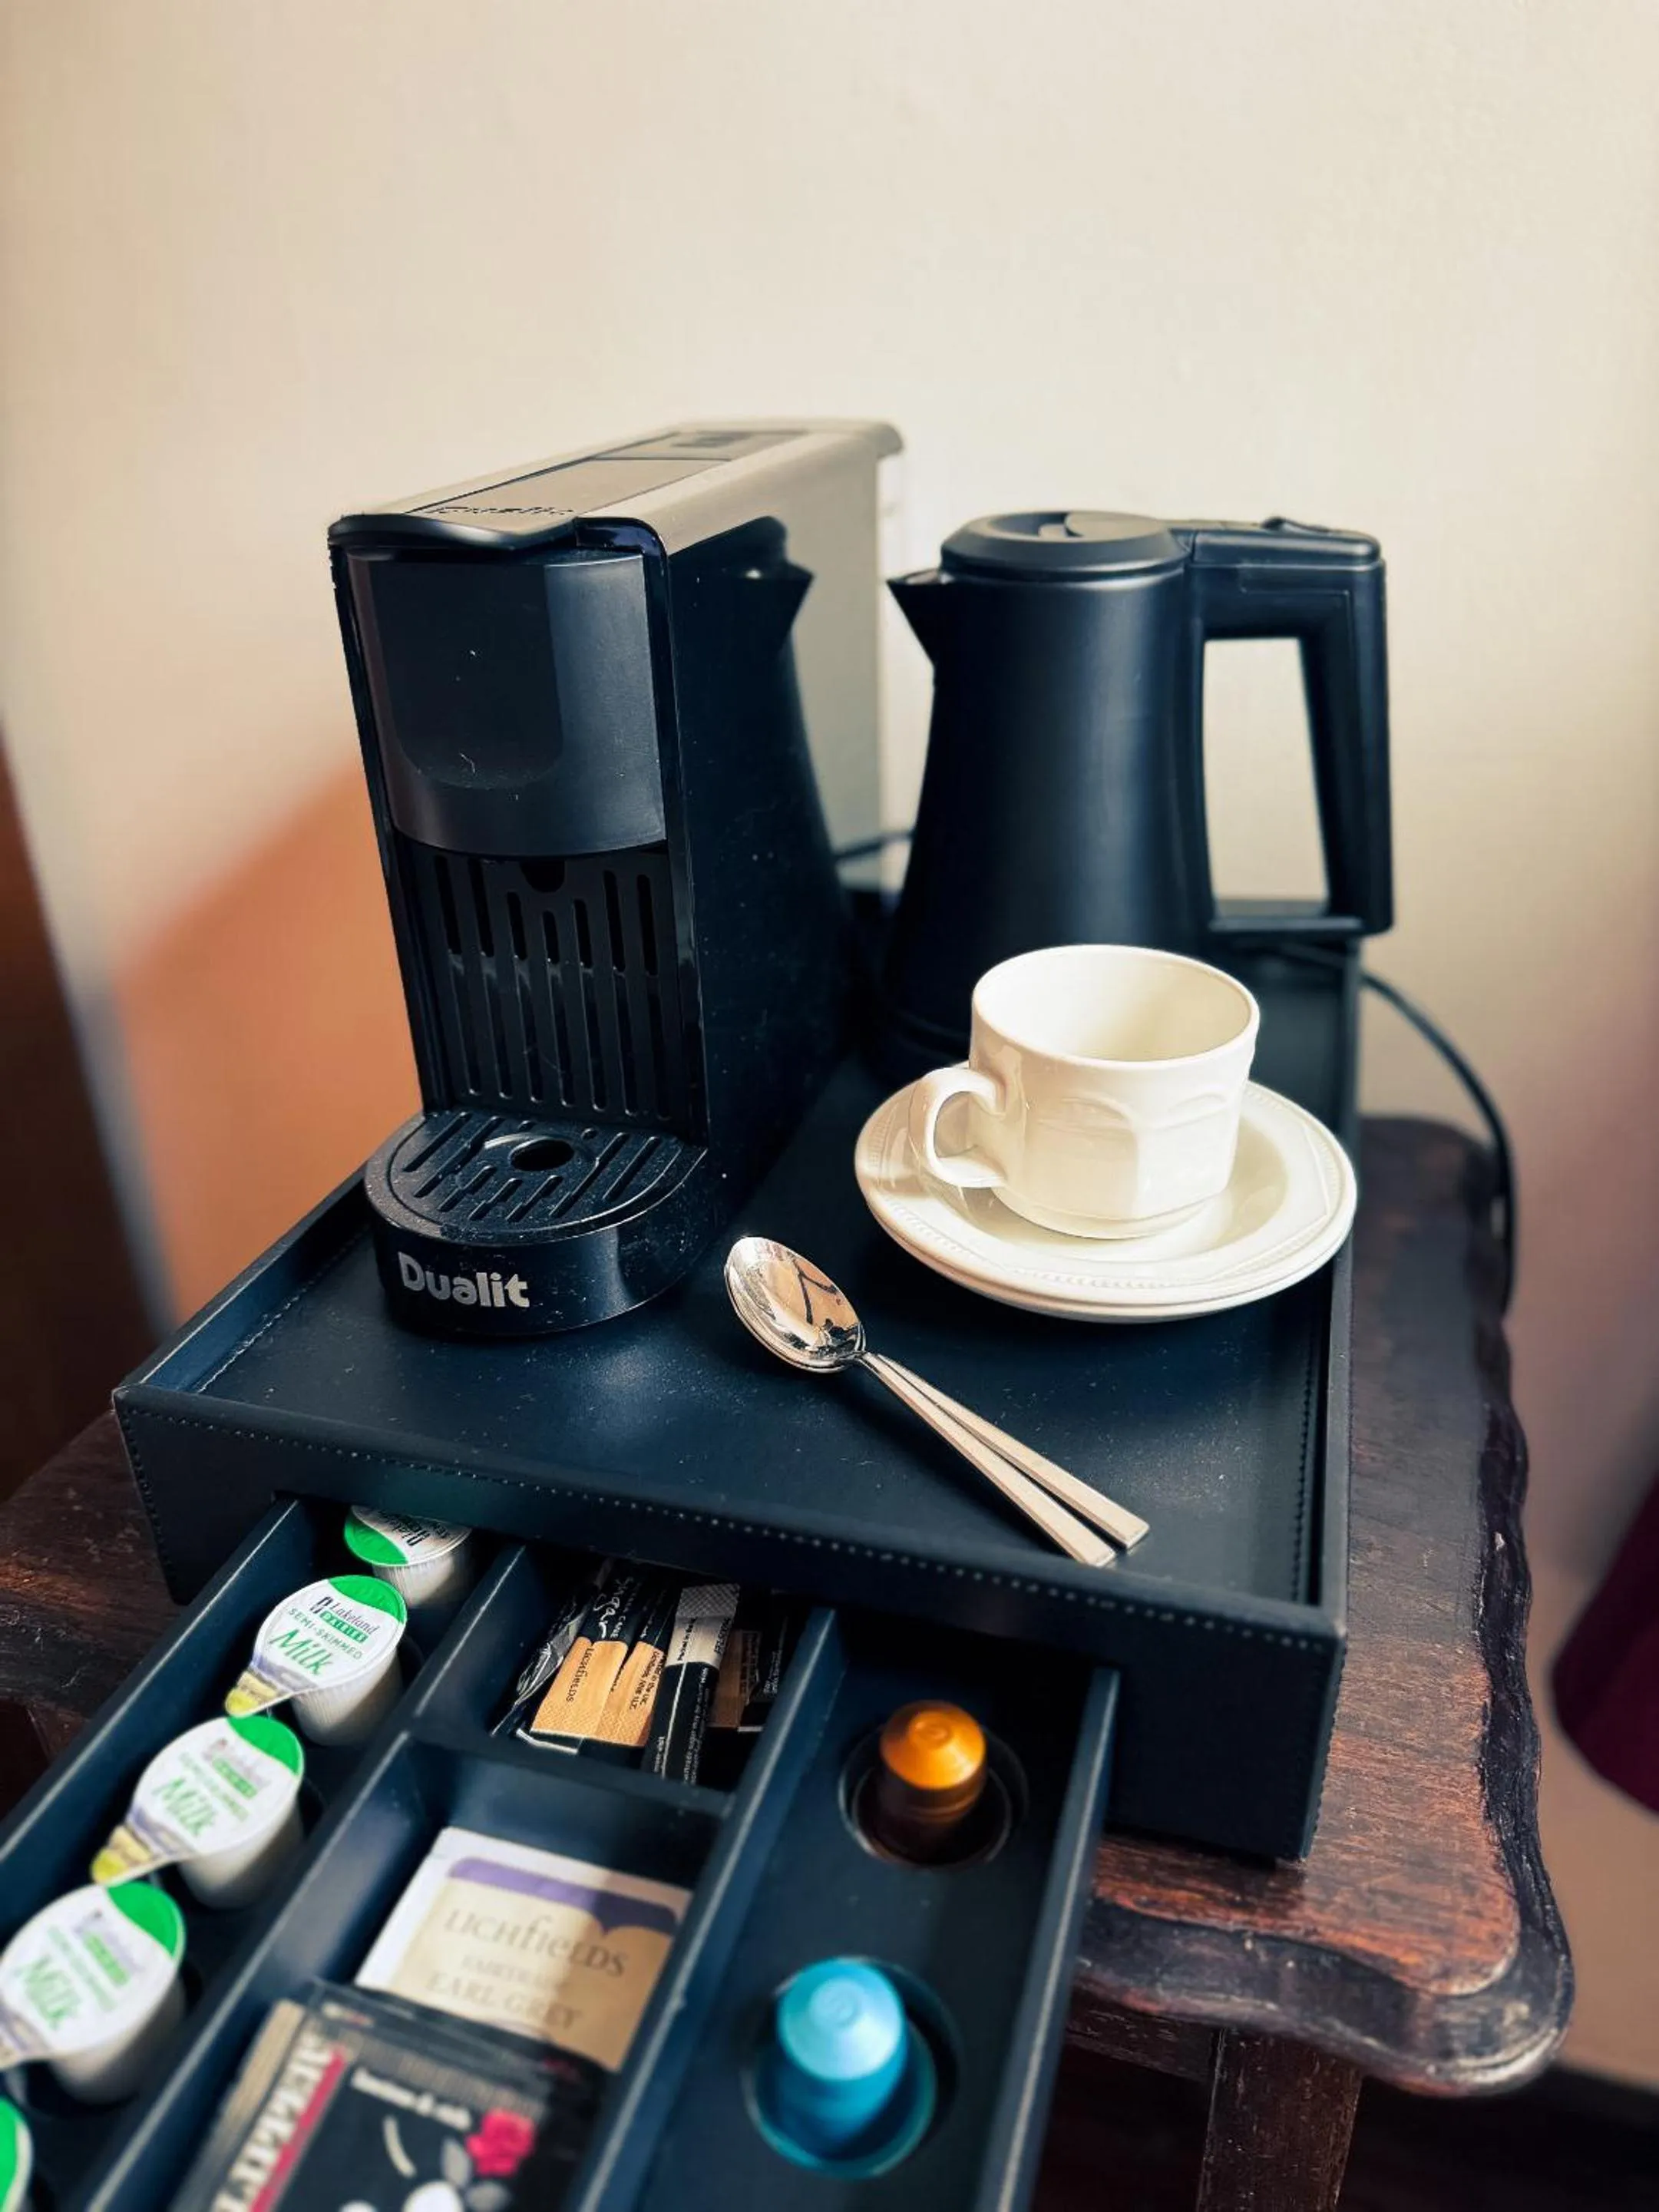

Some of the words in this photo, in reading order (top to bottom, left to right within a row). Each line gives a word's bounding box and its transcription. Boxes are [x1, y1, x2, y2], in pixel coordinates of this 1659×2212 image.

[398, 1251, 530, 1308] Dualit
[289, 1608, 362, 1660] SEMI-SKIMMED
[329, 1602, 379, 1635] Lakeland
[269, 1628, 335, 1675] Milk
